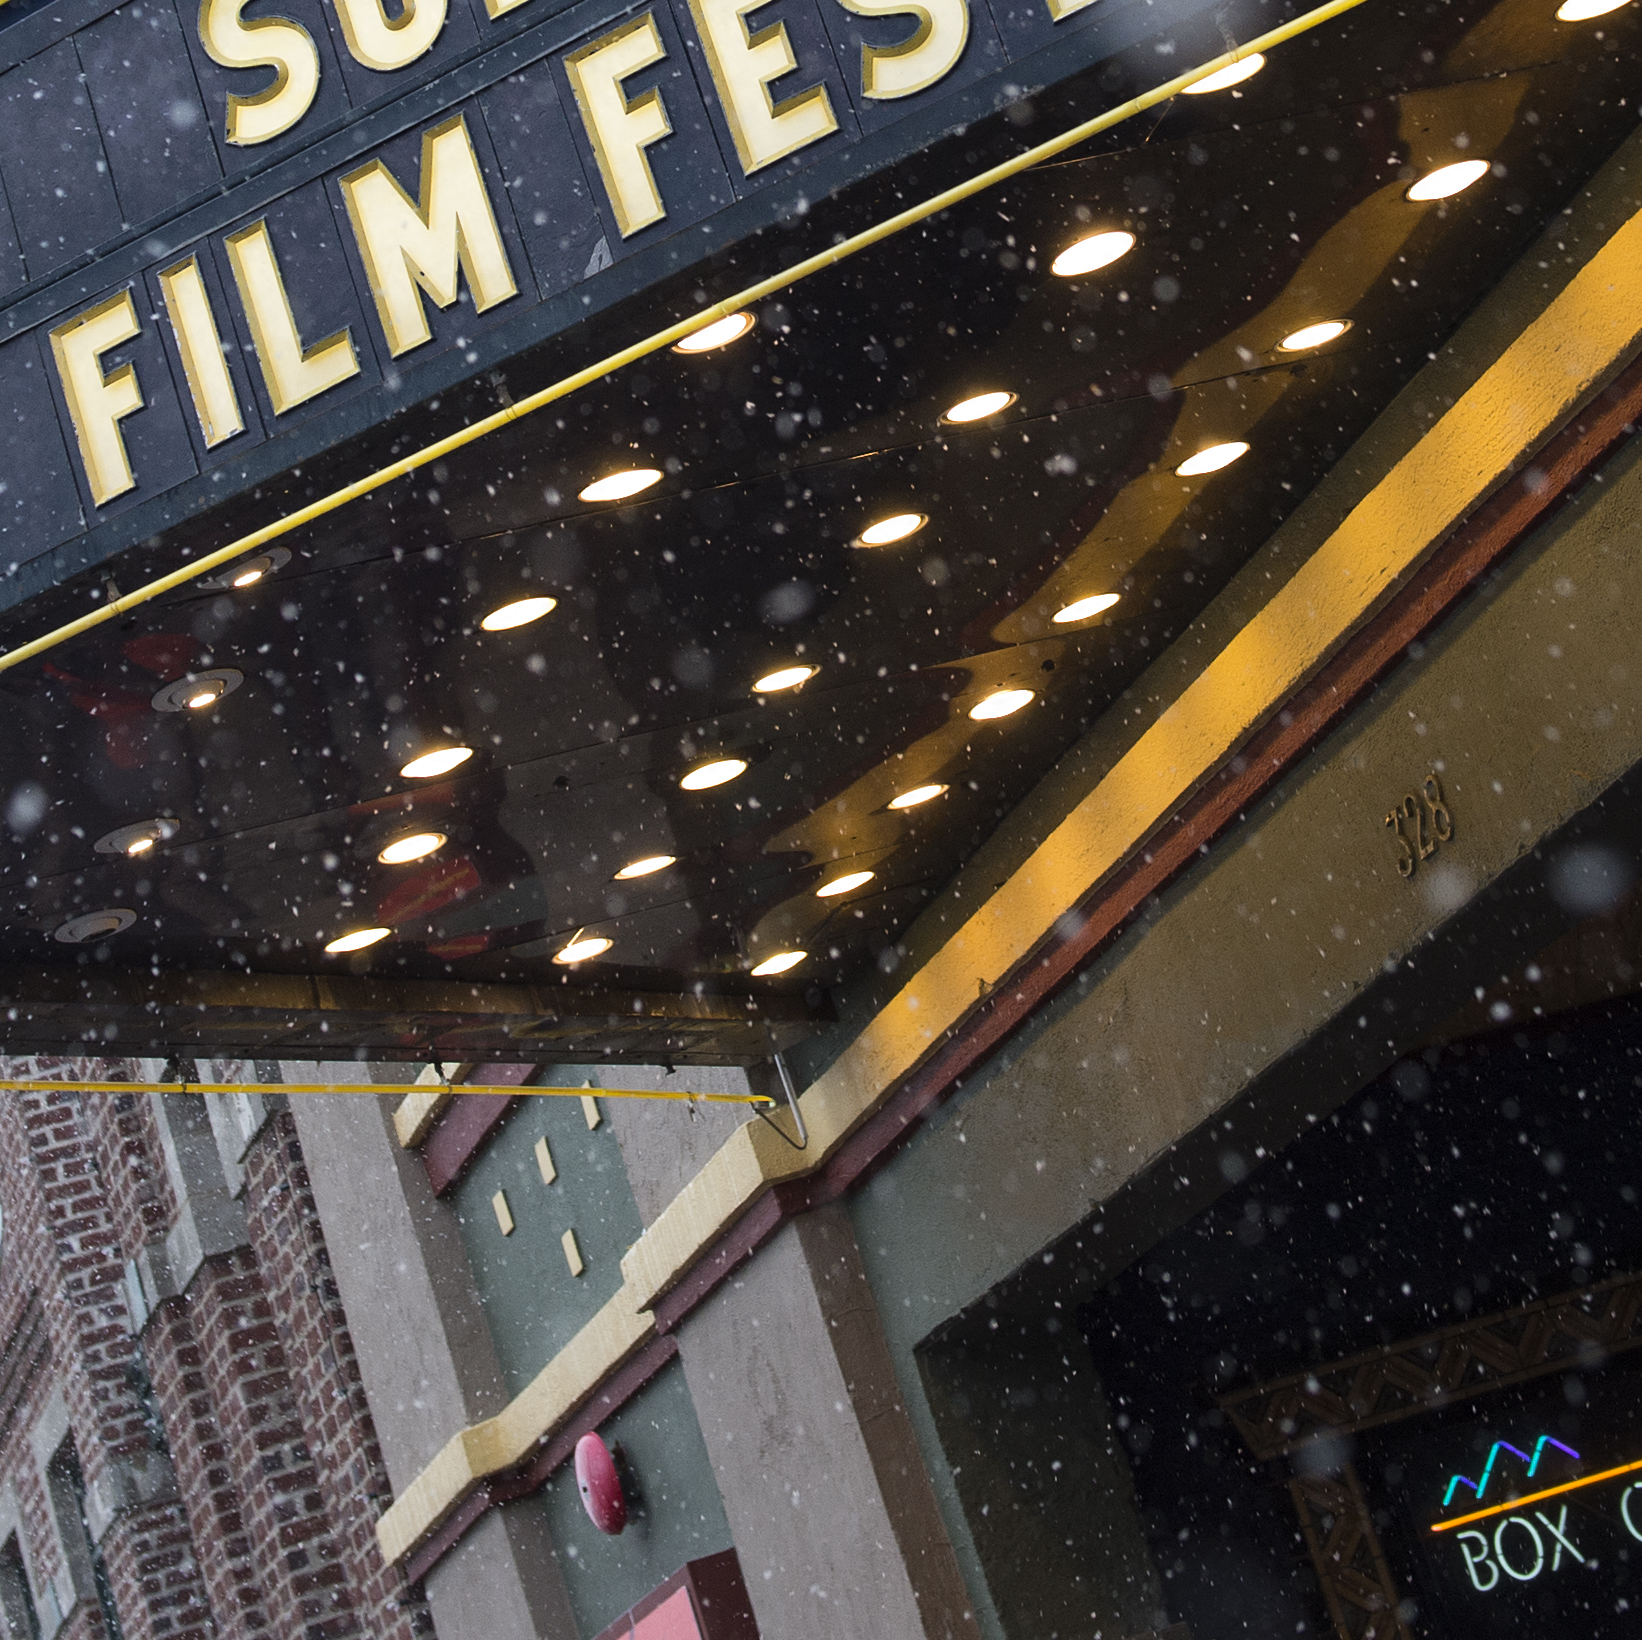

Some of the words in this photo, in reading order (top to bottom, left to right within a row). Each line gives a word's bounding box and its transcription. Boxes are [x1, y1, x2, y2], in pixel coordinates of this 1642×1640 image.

[48, 111, 522, 509] FILM
[1385, 774, 1452, 878] 328
[1457, 1505, 1585, 1591] BOX
